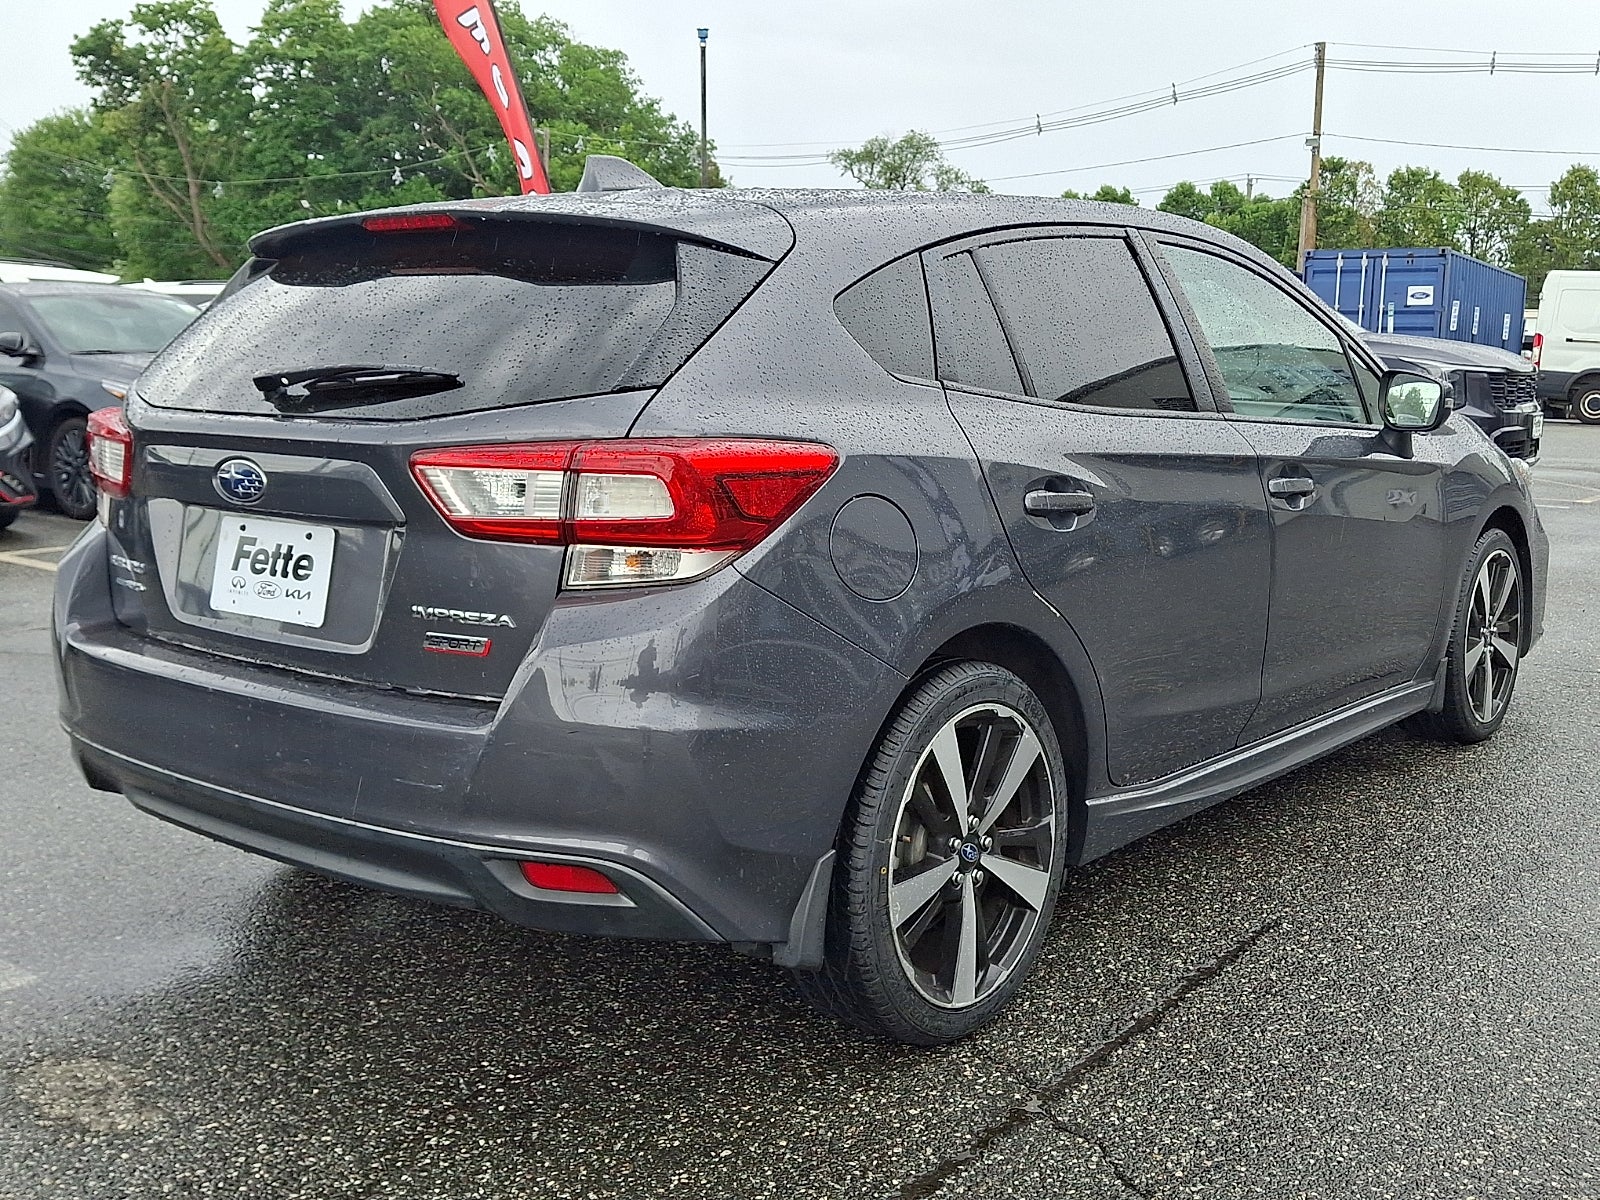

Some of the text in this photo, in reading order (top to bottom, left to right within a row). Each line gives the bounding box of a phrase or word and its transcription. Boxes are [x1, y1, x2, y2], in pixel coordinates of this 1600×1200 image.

[231, 535, 314, 581] Fette
[256, 582, 279, 598] Ford
[411, 605, 517, 628] IMPREZA
[428, 637, 483, 651] SPORT
